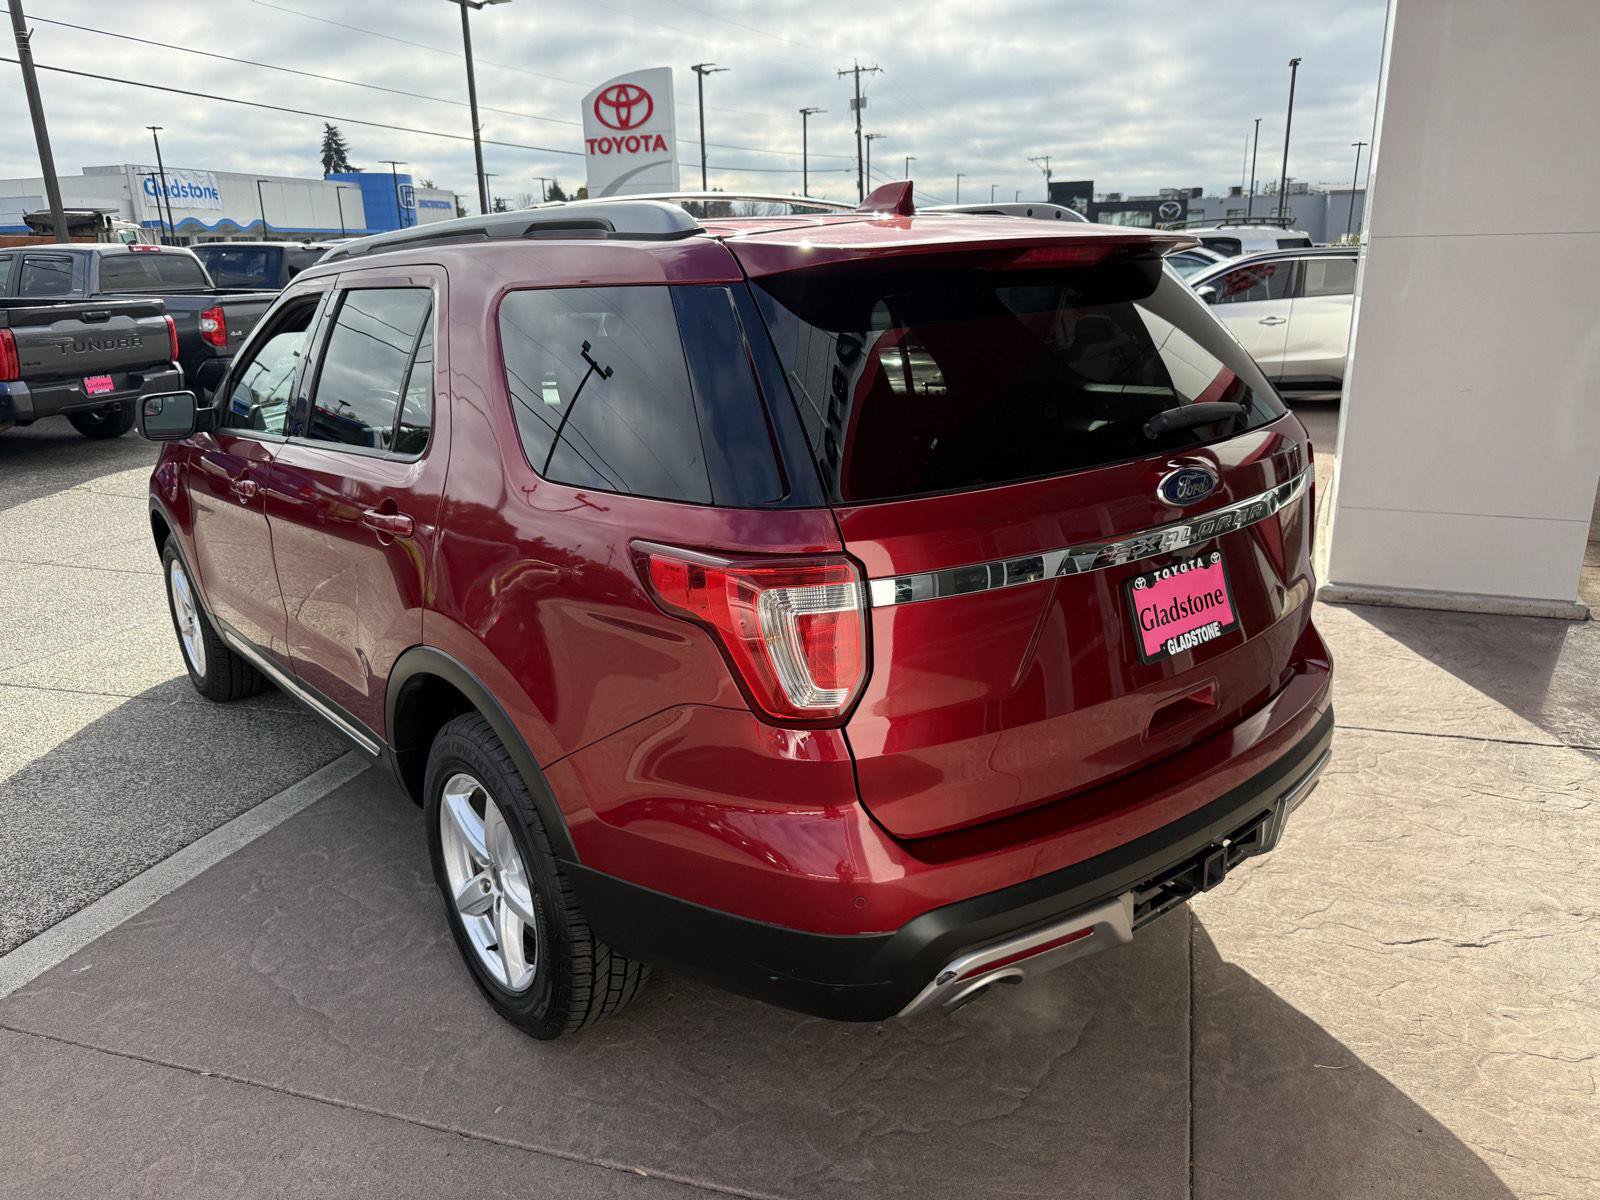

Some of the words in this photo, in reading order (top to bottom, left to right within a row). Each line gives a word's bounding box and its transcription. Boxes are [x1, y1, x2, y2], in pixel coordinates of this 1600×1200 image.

[586, 134, 668, 155] TOYOTA
[56, 336, 144, 355] TUNDRA
[1176, 472, 1210, 499] Ford
[1111, 503, 1263, 562] EXPLORER
[1153, 557, 1204, 583] TOYOTA
[1140, 588, 1224, 632] Gladstone
[1167, 621, 1221, 656] GLADSTONE
